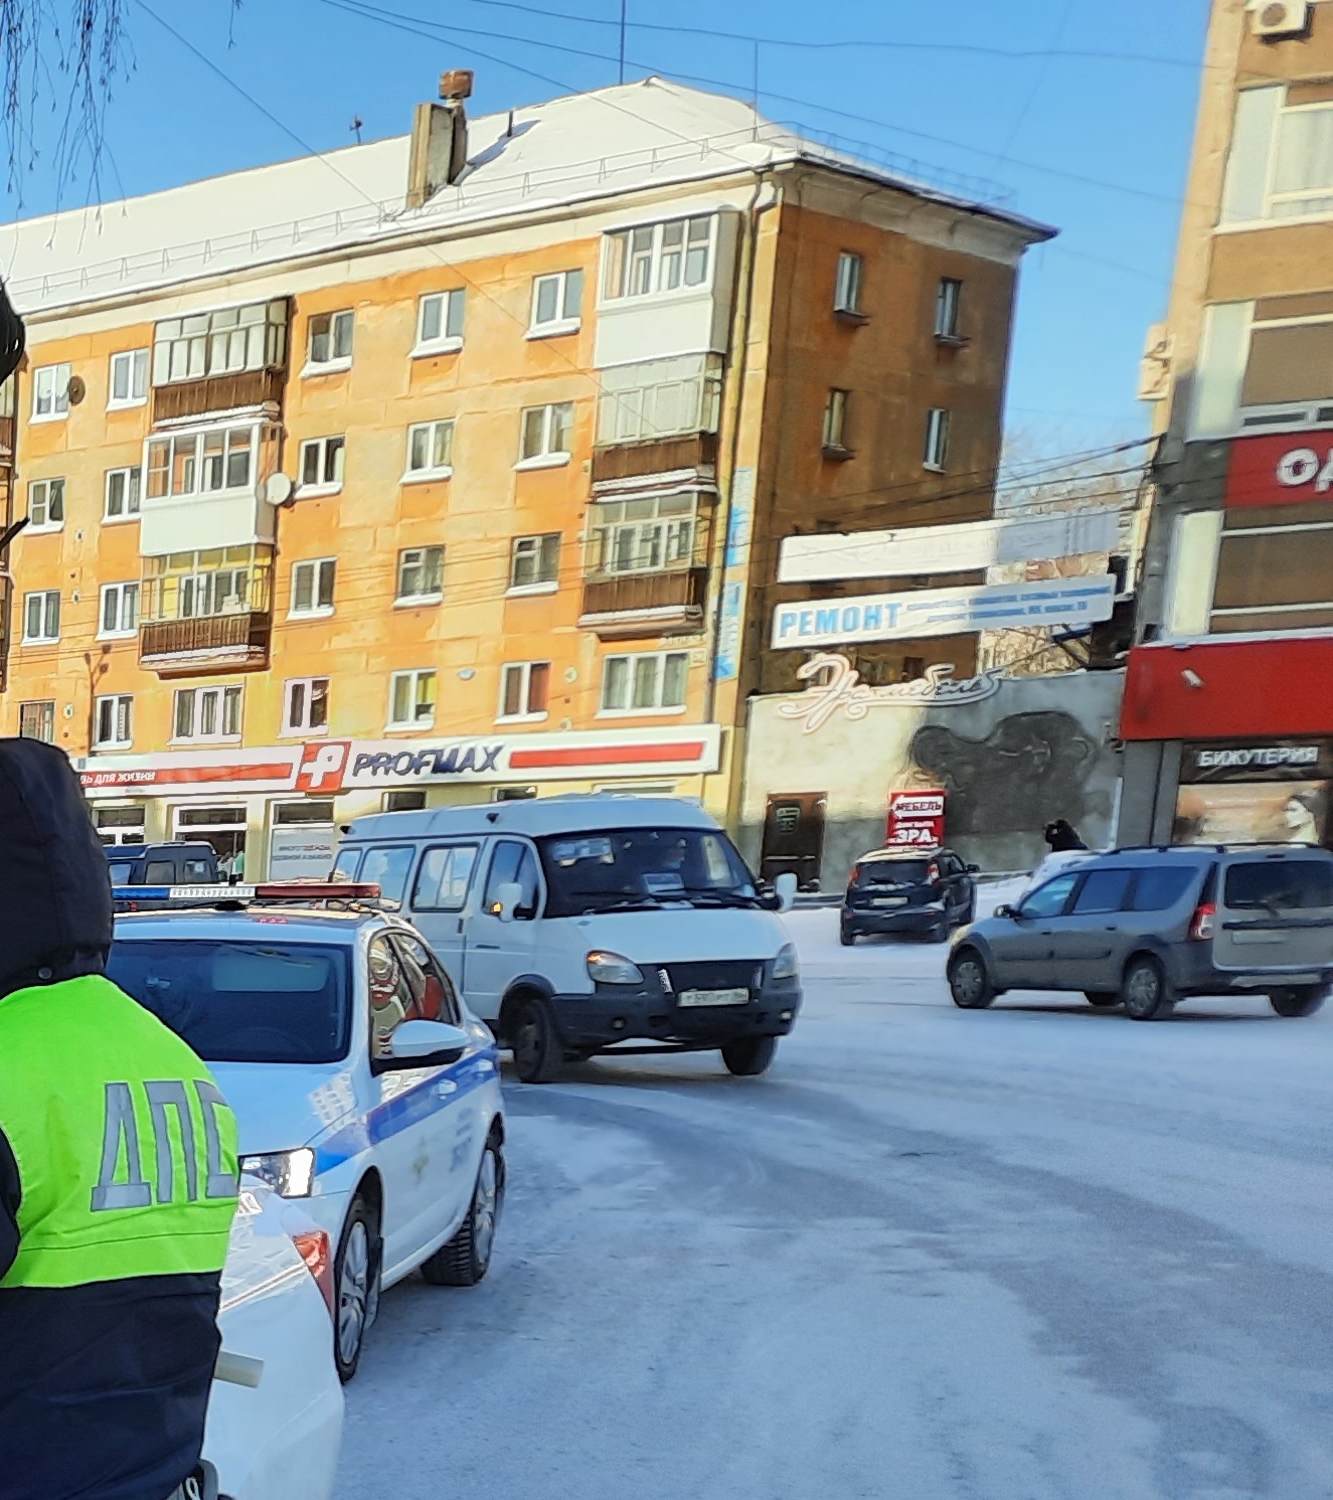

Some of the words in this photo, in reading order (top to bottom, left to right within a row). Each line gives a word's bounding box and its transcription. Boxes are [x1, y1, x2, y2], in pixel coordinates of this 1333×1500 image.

[780, 602, 902, 639] РЕМОНТ
[352, 742, 505, 777] PROFMAX
[1197, 746, 1319, 767] БИЖУТЕРИЯ
[895, 801, 942, 811] МЕБЕЛЬ
